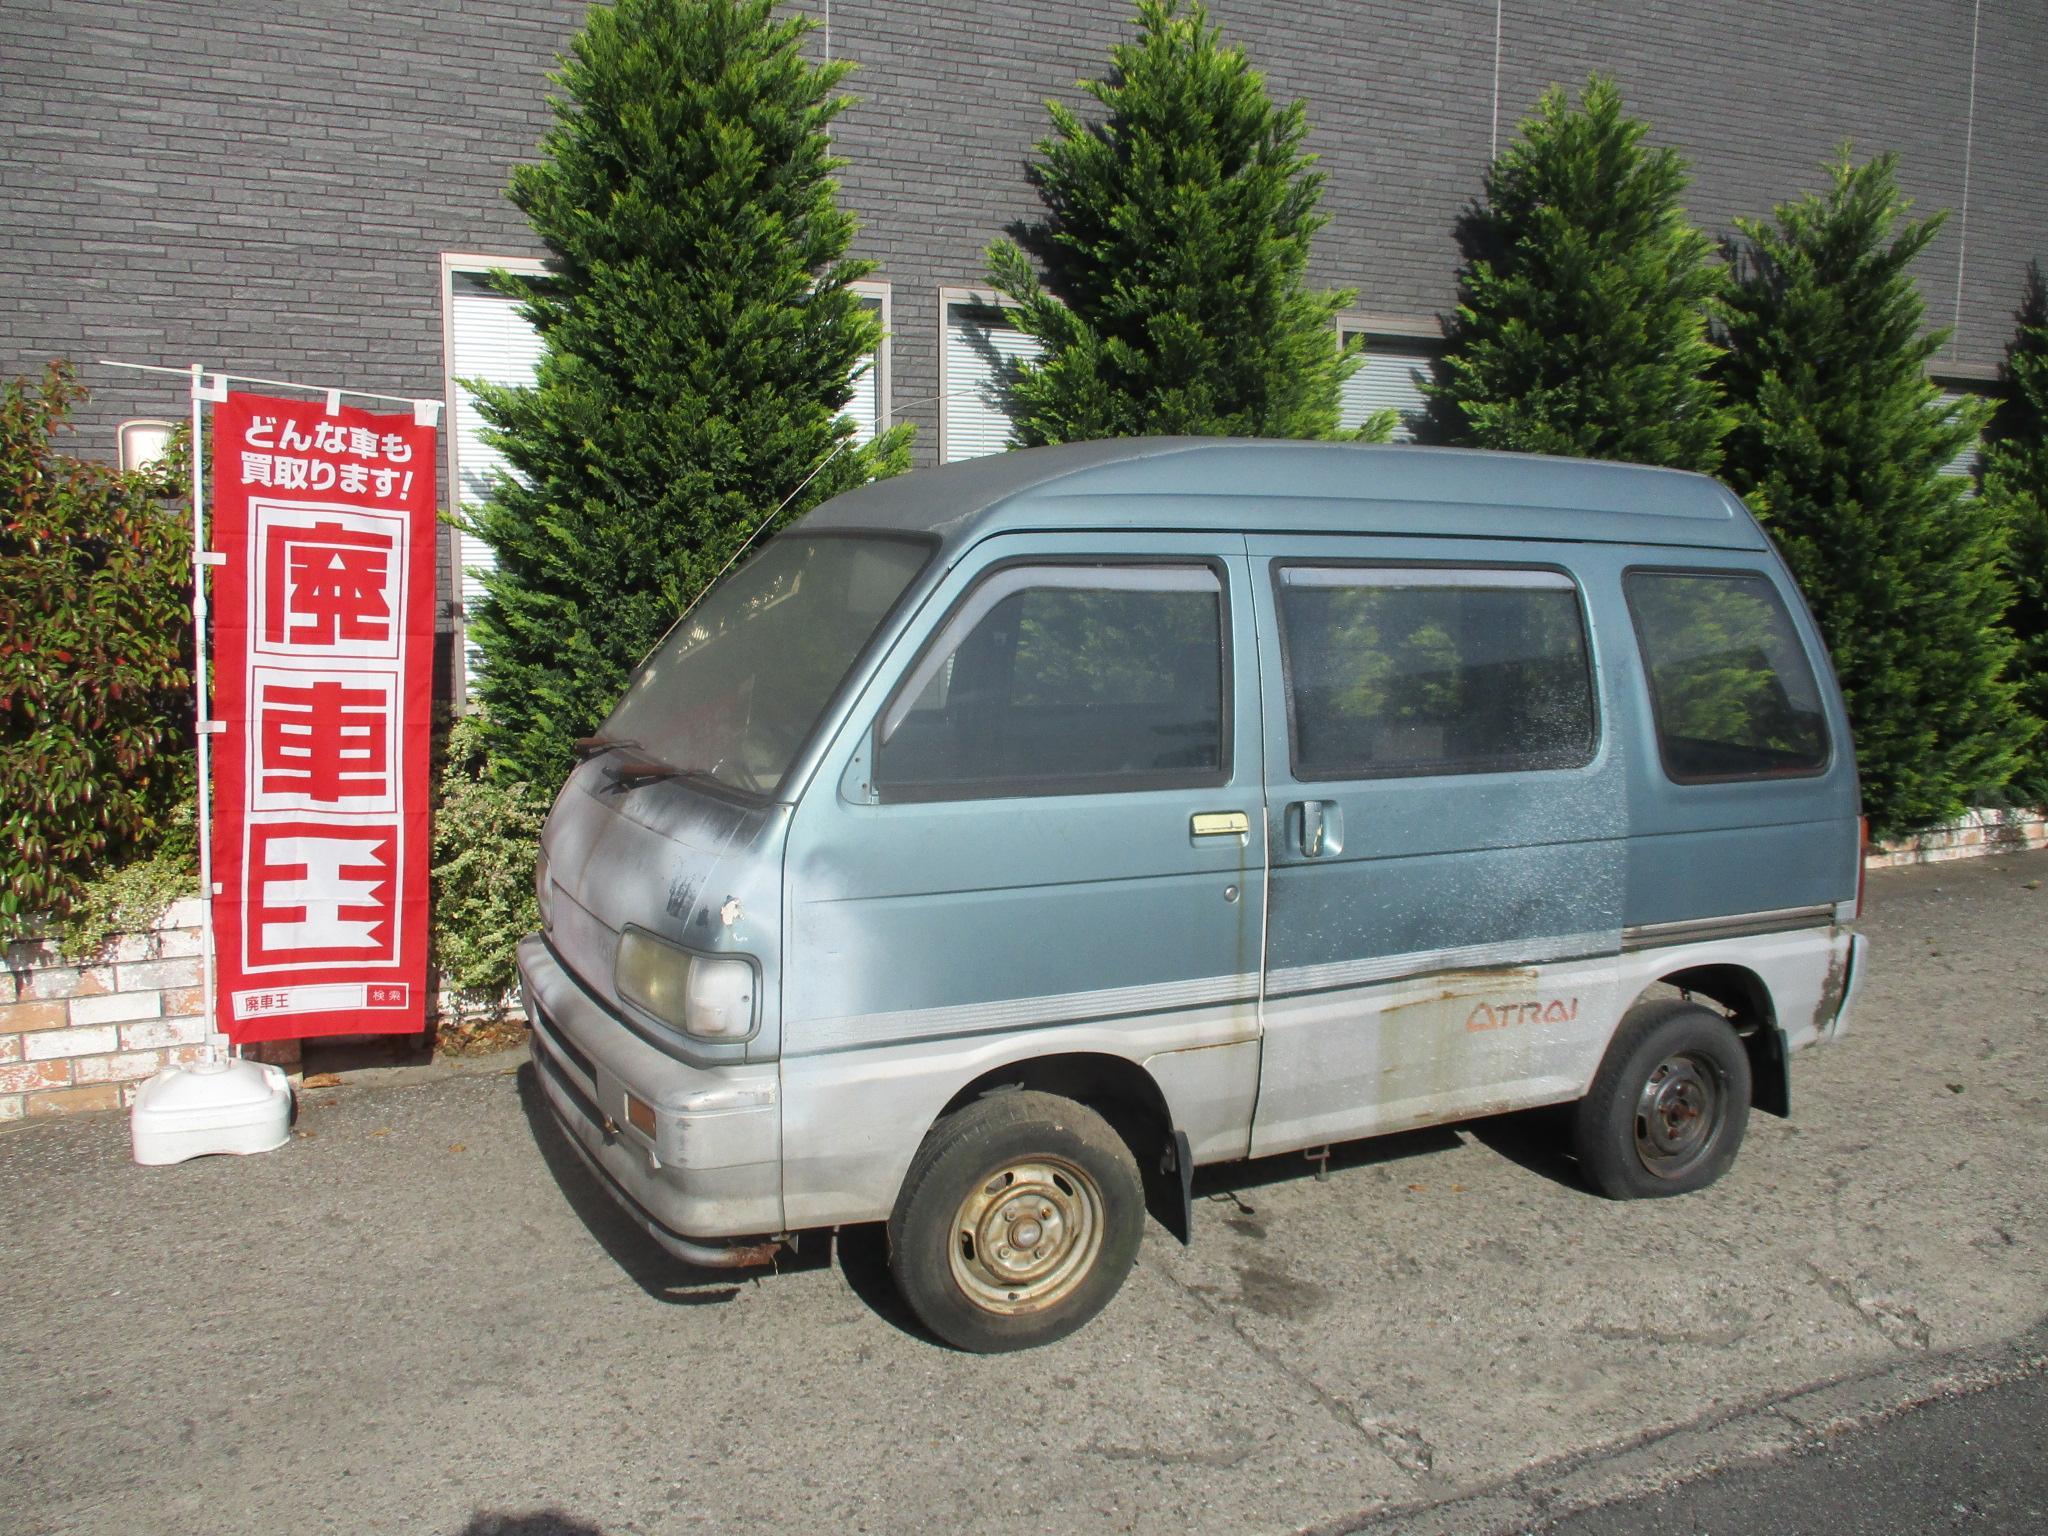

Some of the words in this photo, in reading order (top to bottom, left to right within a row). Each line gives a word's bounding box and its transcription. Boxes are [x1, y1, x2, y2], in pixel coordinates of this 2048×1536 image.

[245, 415, 412, 463] どんな車も
[241, 450, 413, 501] 買取ります!
[261, 521, 394, 952] 廃車王
[245, 992, 289, 1012] 廃車王
[372, 988, 401, 1002] 検索
[1466, 998, 1578, 1032] ATRAI
